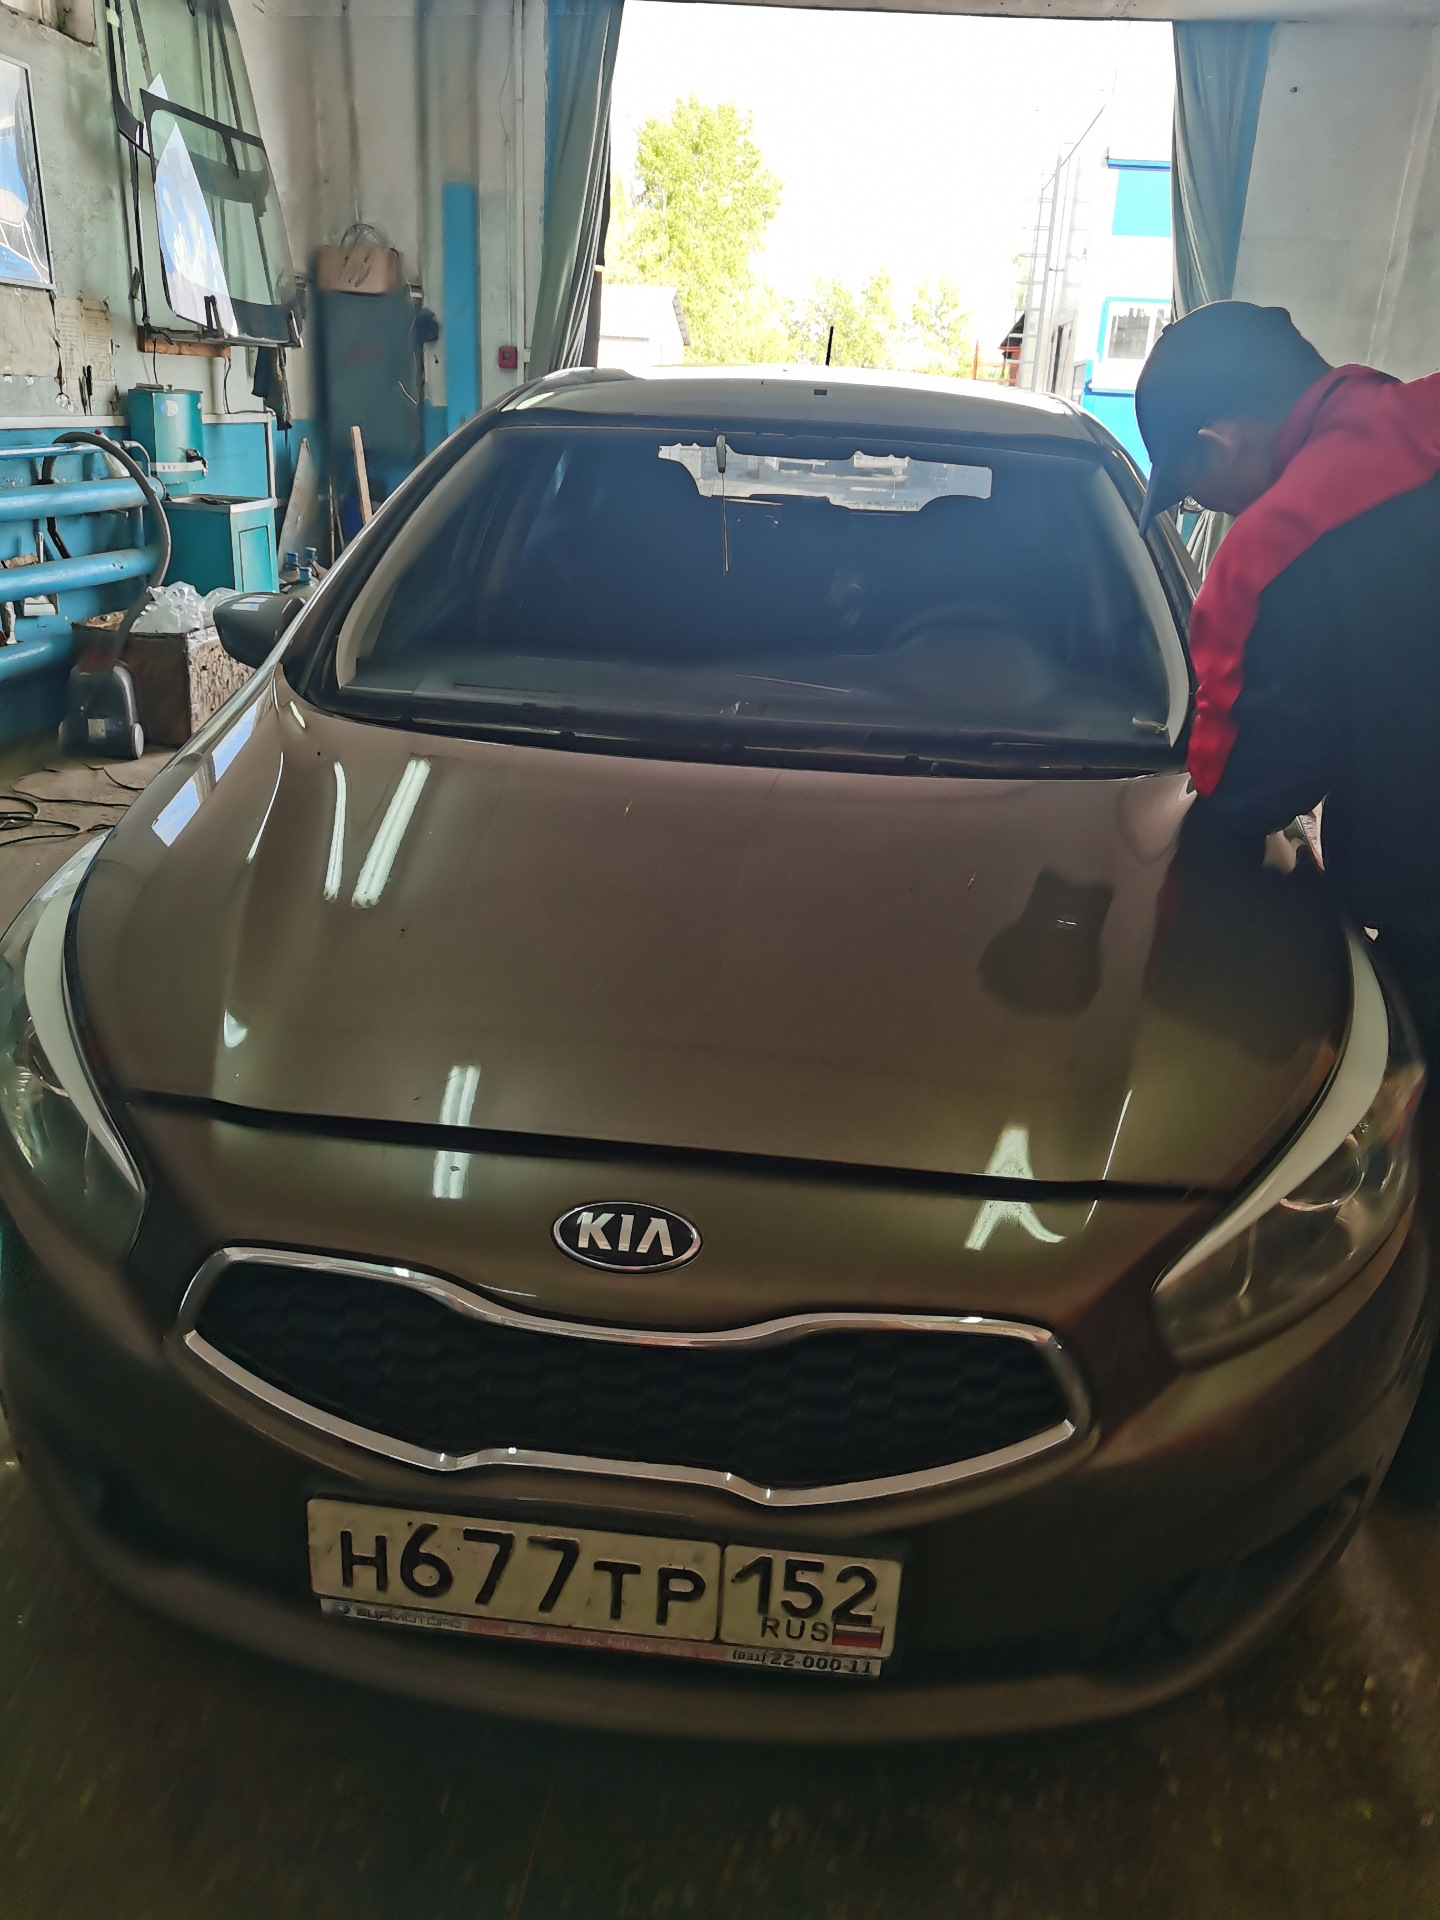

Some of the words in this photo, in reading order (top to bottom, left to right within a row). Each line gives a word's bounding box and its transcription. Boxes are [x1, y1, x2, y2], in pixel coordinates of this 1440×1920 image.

[576, 1211, 674, 1256] KIA
[731, 1555, 878, 1625] 152
[761, 1616, 829, 1642] RUS
